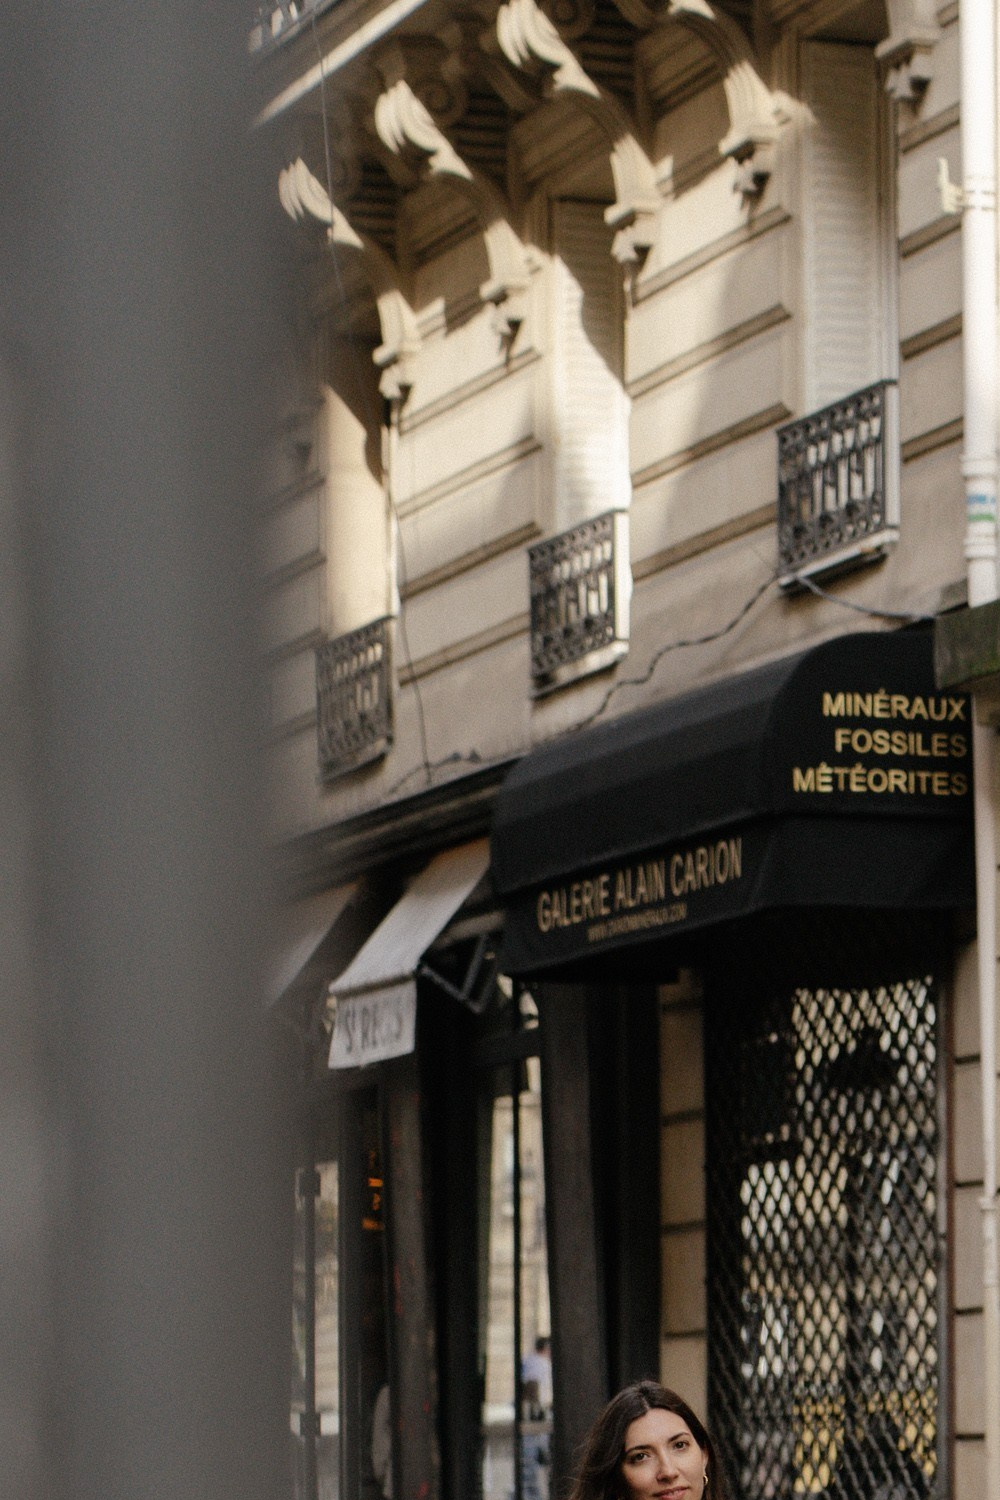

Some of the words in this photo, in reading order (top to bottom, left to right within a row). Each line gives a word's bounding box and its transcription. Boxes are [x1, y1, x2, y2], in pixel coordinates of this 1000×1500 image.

[822, 688, 966, 721] MINÉRAUX
[834, 728, 968, 758] FOSSILES
[792, 761, 968, 796] MÉTÉORITES
[537, 873, 611, 932] GALERIE
[614, 859, 666, 912] ALAIN
[670, 837, 743, 897] CARION
